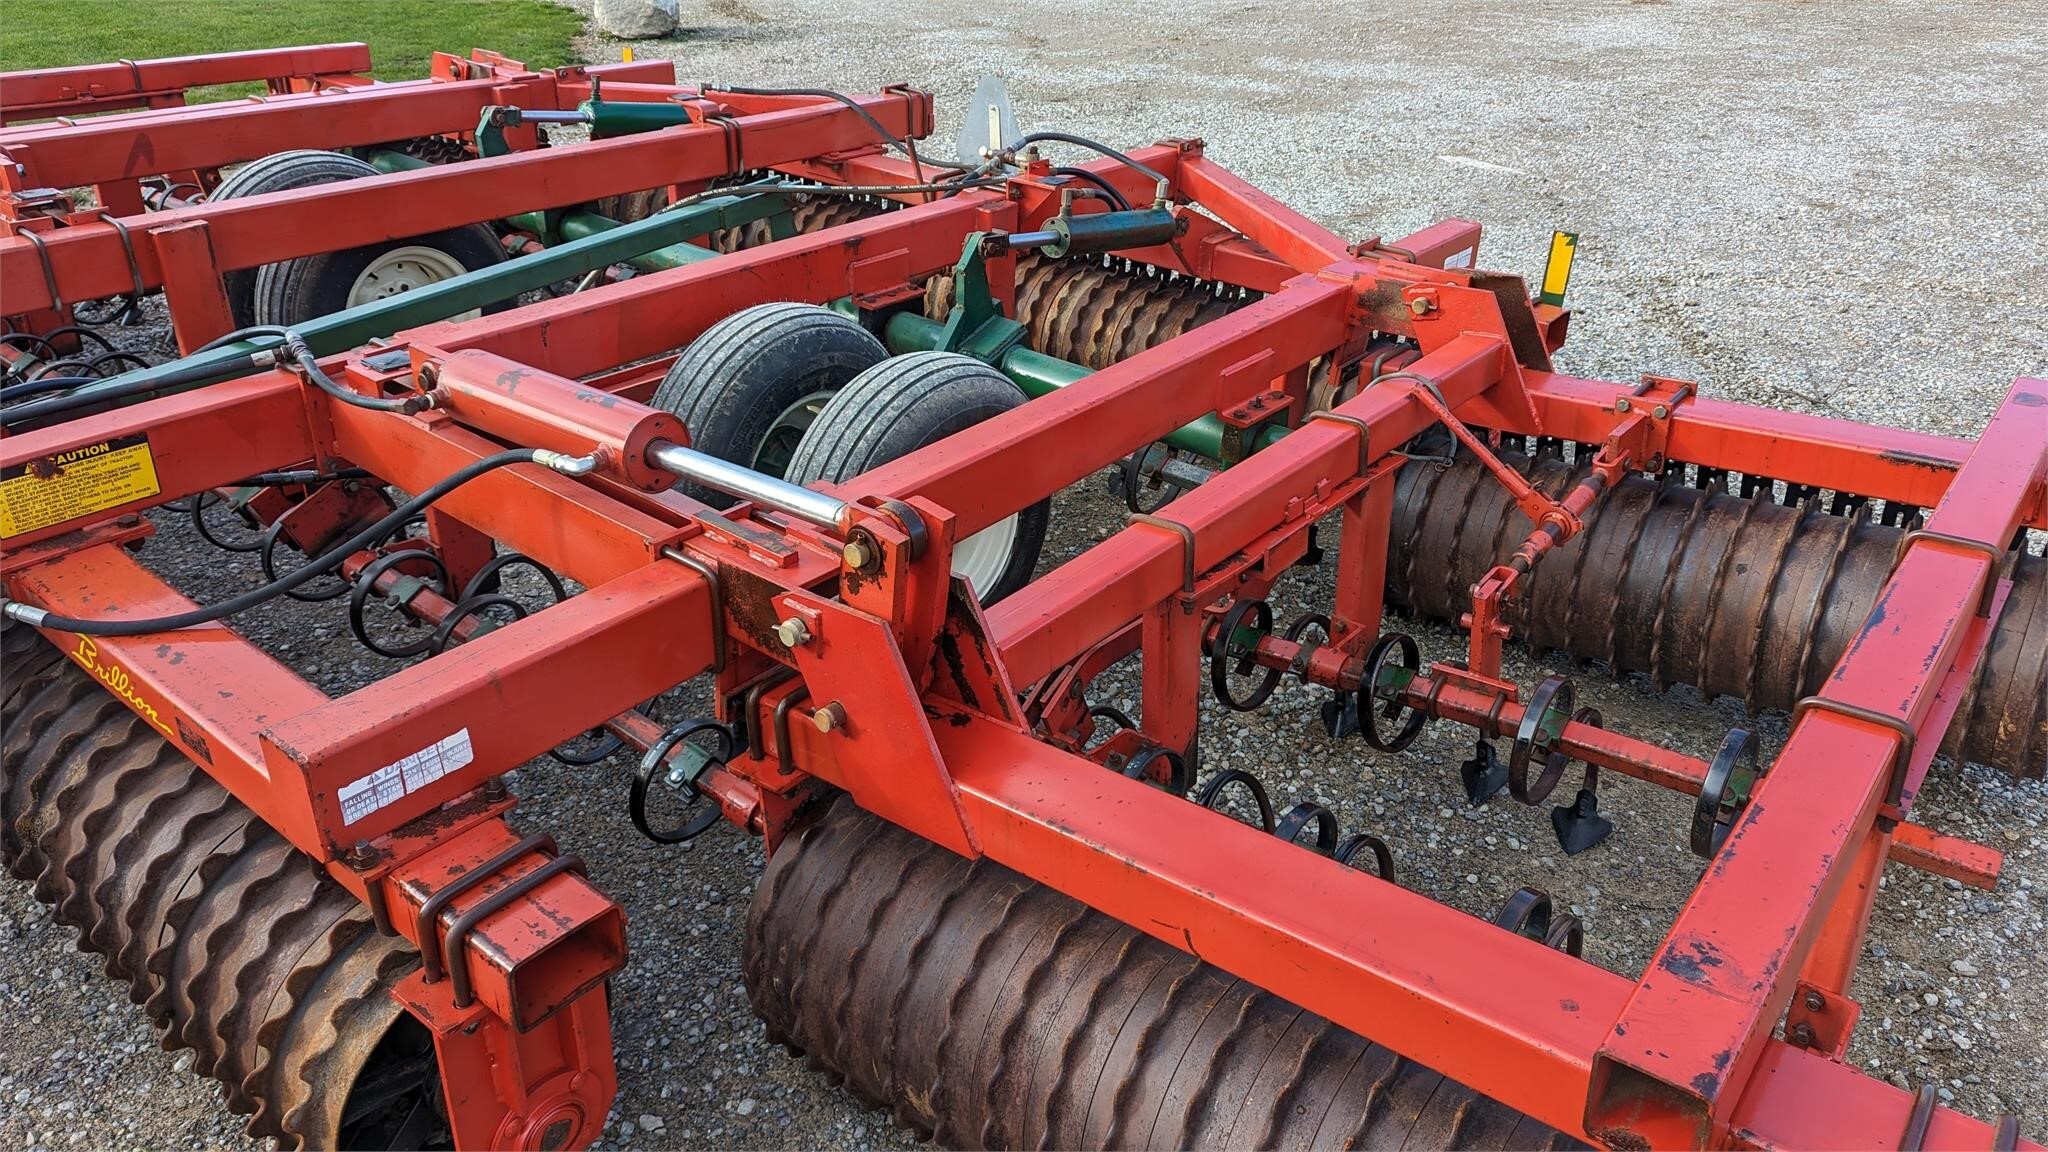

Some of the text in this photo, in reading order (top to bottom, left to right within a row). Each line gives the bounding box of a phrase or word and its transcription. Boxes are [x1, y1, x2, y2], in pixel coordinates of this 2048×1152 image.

[110, 455, 133, 463] TRACTOR
[64, 461, 84, 470] CAUSE
[76, 473, 102, 482] BETWEEN
[104, 465, 128, 474] TRACTOR
[38, 479, 61, 488] MOVING
[78, 483, 99, 491] BEHIND
[100, 474, 131, 485] IMPLEMENT
[7, 494, 40, 506] IMPLEMENT
[63, 492, 85, 500] BACKED
[77, 501, 101, 510] PREVENT
[103, 492, 133, 502] MOVEMENT
[79, 492, 100, 500] OTHERS
[14, 514, 39, 523] TRACTOR
[16, 521, 48, 532] UNHITCHED
[72, 632, 174, 736] Brillion
[344, 790, 372, 808] FALLING
[377, 776, 399, 791] WINGS
[346, 805, 356, 814] OR
